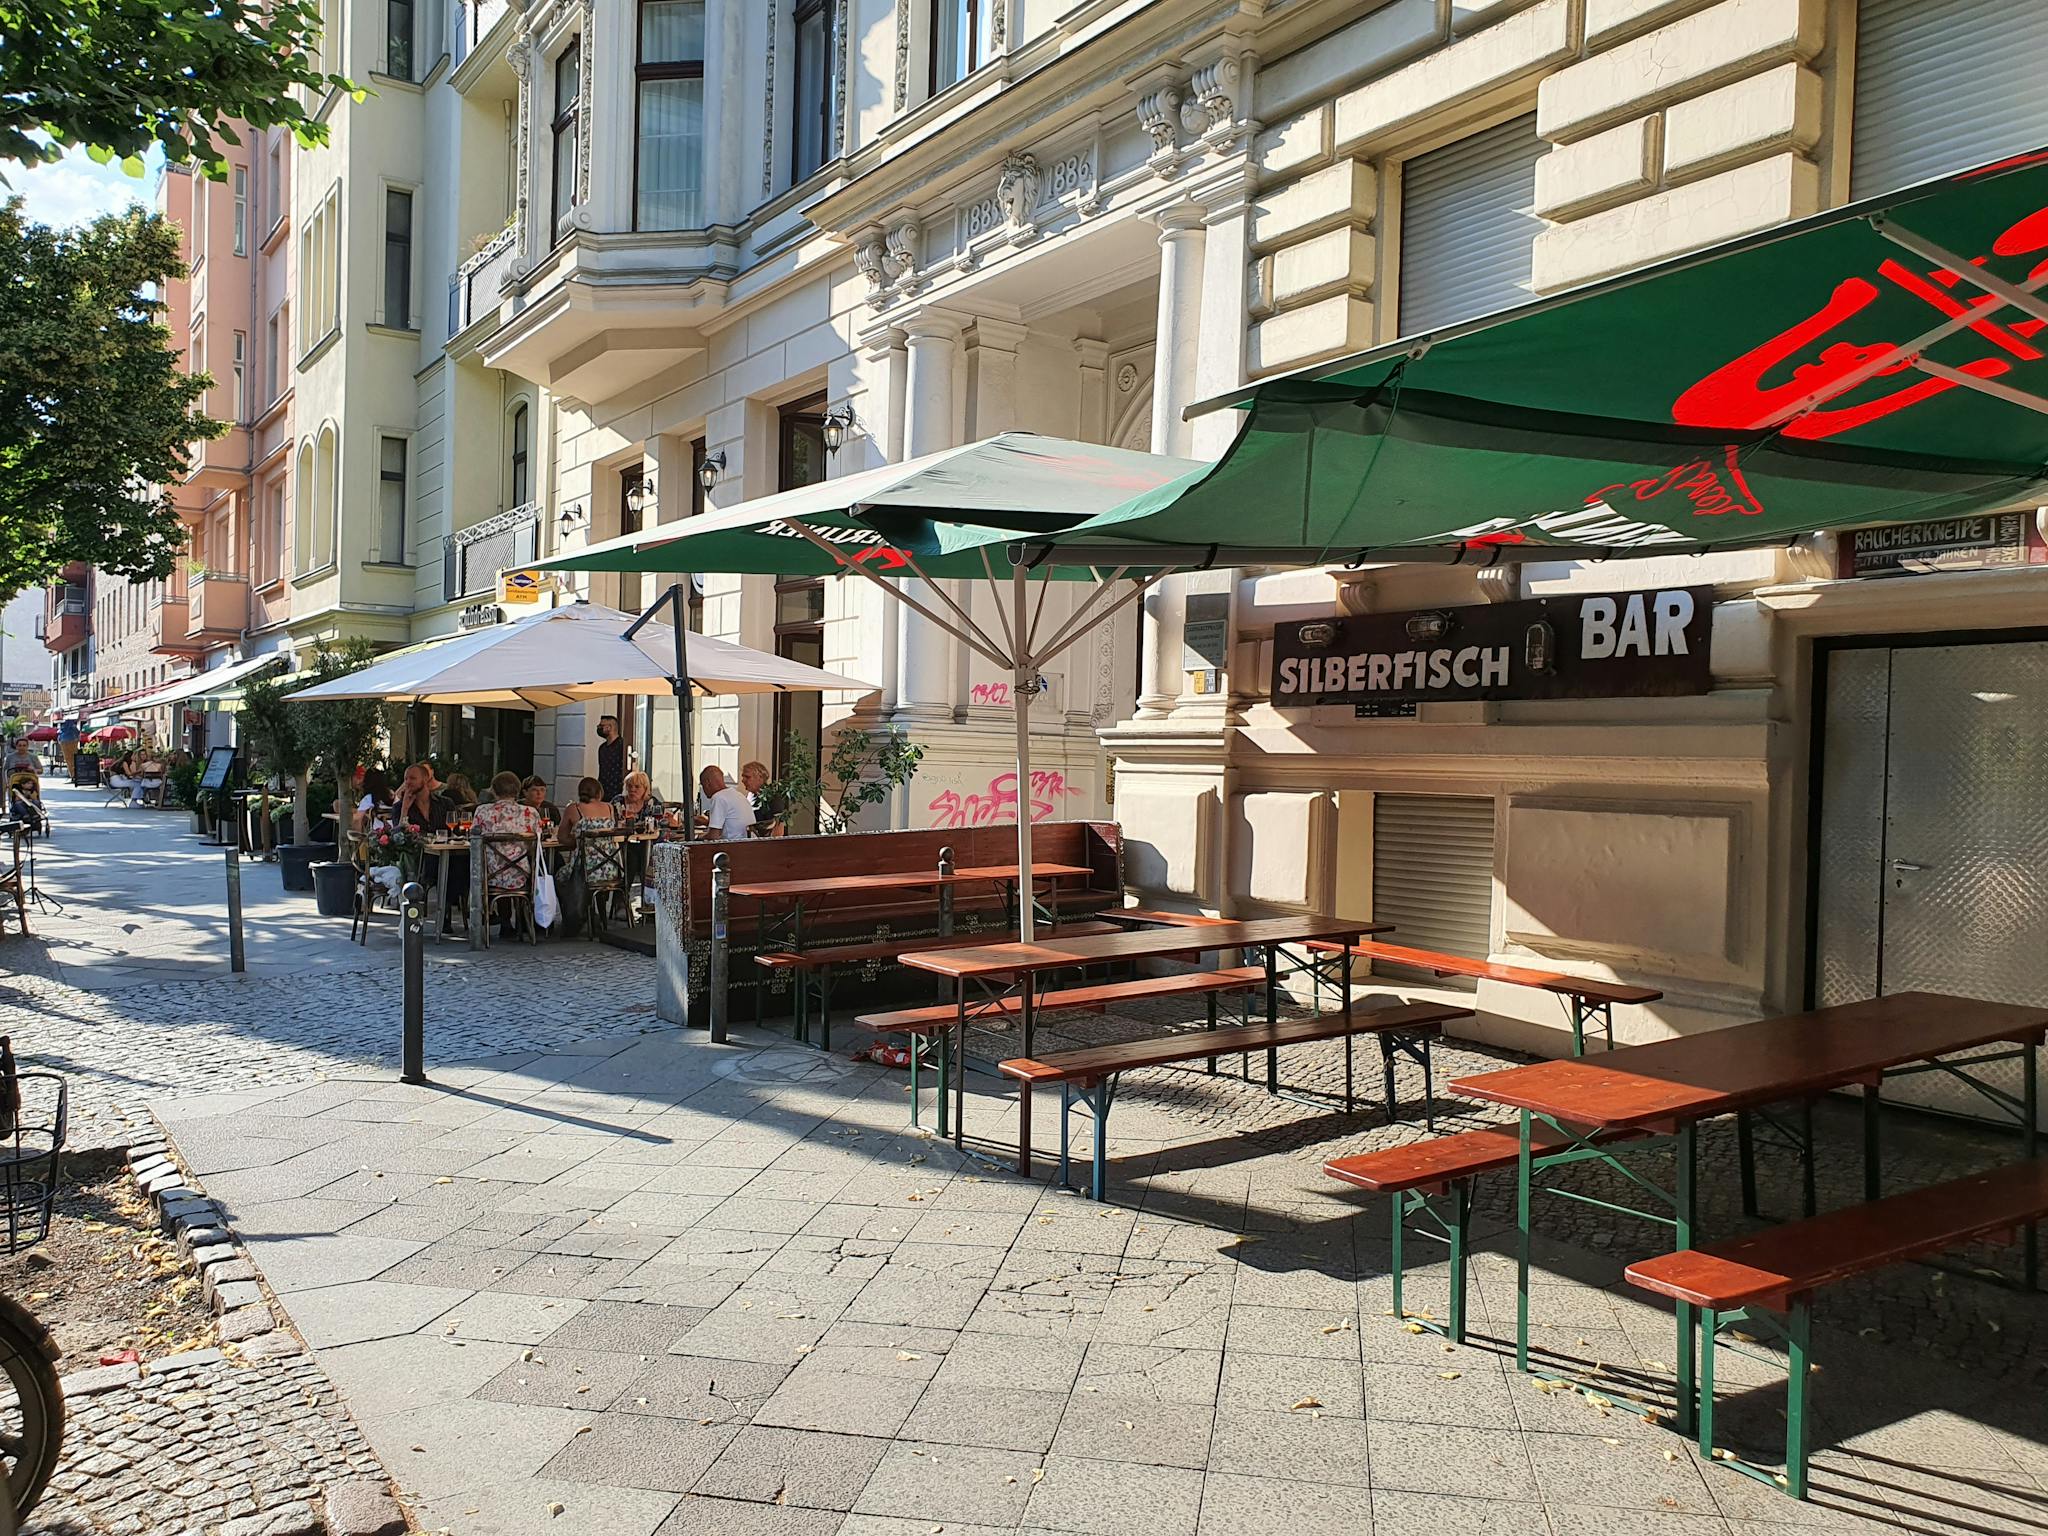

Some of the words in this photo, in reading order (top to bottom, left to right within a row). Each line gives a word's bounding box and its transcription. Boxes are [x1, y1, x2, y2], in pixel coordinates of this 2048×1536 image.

[1855, 518, 1985, 551] RAUCHERKNEIPE
[1934, 546, 1979, 563] JAHREN
[1580, 589, 1695, 659] BAR
[1279, 645, 1510, 694] SILBERFISCH
